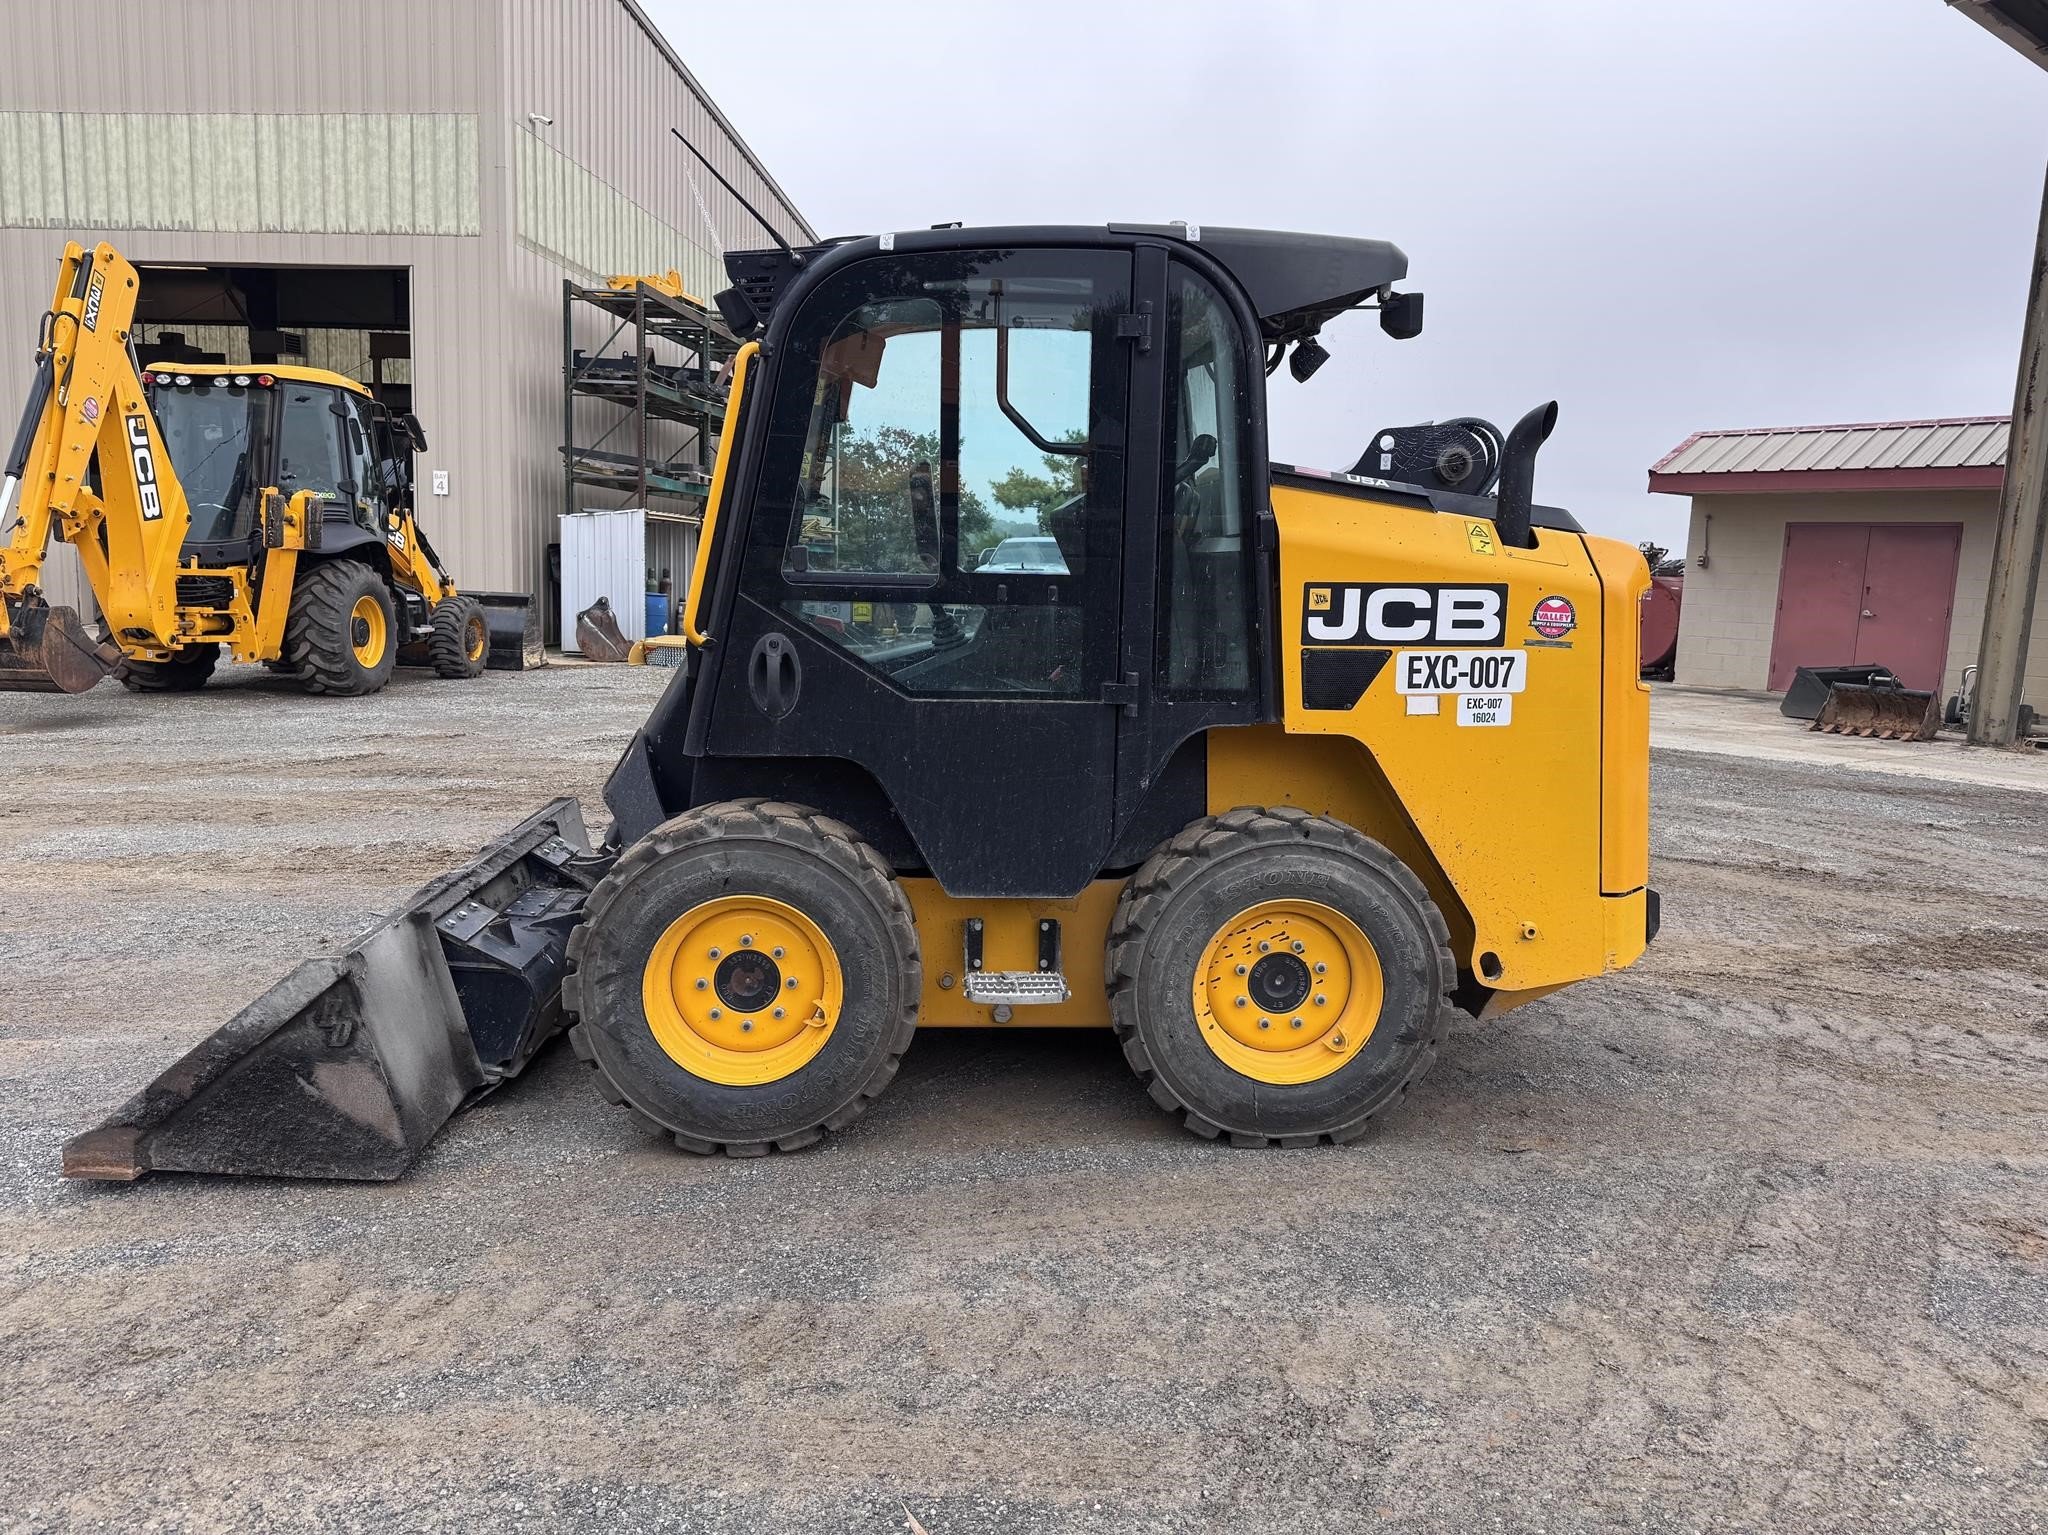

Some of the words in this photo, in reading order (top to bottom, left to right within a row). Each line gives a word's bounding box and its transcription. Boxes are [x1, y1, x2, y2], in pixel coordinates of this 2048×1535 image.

[128, 418, 160, 519] JCB
[434, 472, 447, 480] BAY
[1346, 473, 1390, 488] USA
[436, 481, 445, 492] 4
[1307, 588, 1501, 641] JCB
[1538, 612, 1571, 622] VALLEY
[1406, 655, 1516, 690] EXC-007
[1466, 697, 1503, 710] EXC-007
[1471, 711, 1497, 724] 16024
